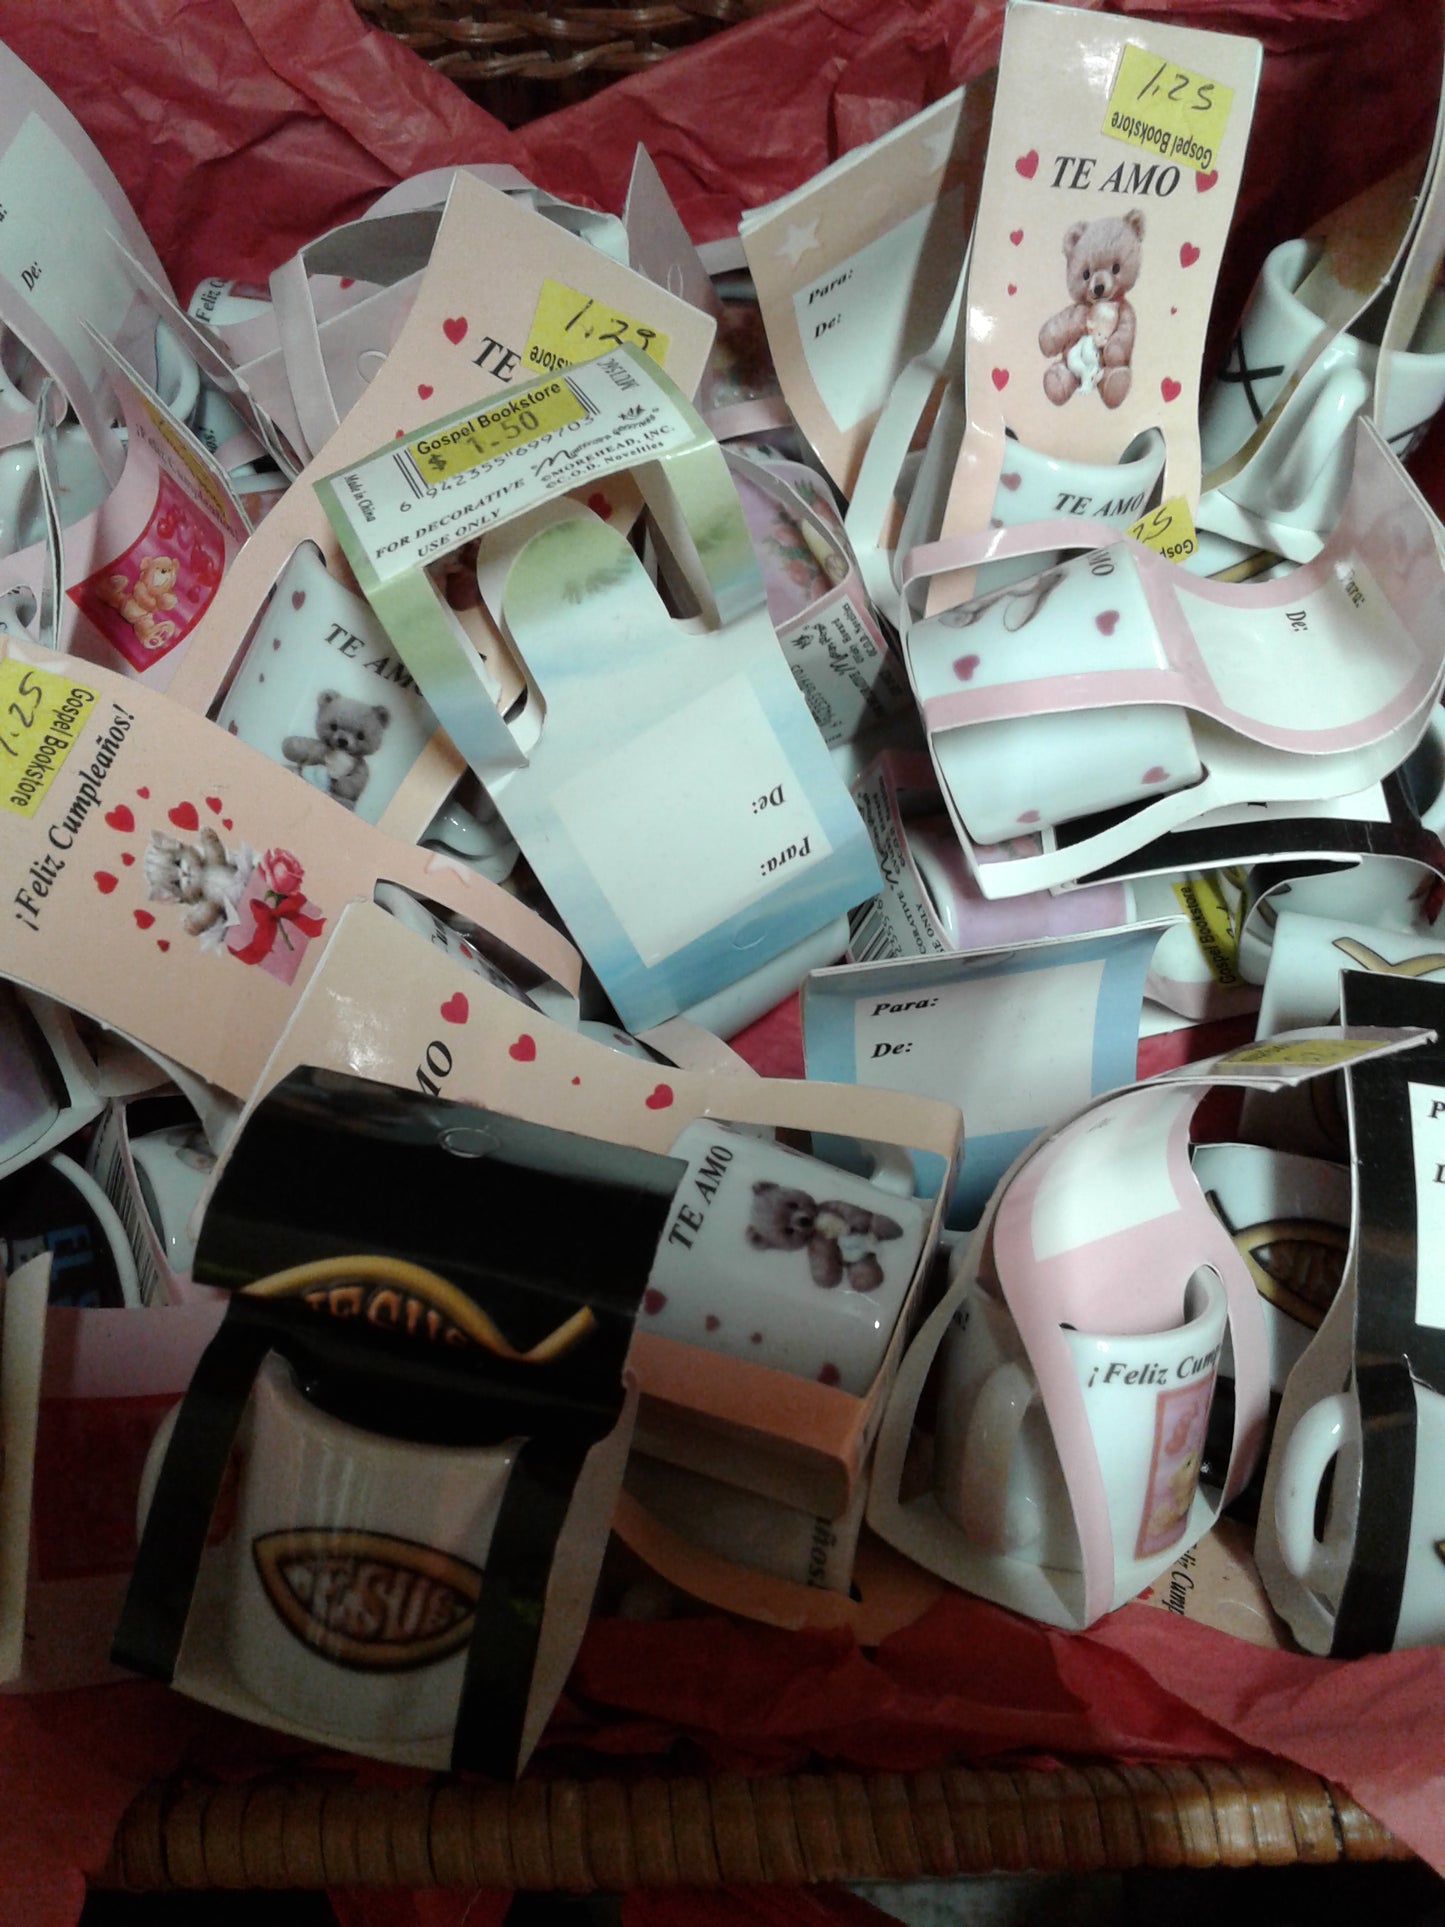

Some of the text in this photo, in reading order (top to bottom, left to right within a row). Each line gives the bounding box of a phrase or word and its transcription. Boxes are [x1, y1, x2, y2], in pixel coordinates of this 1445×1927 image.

[1110, 110, 1214, 170] Gospel Bookstore
[1050, 155, 1181, 198] TE AMO
[21, 261, 42, 292] De:
[807, 269, 855, 307] Para:
[813, 314, 843, 340] De:
[472, 336, 522, 384] TE
[417, 381, 562, 456] Gospel Bookstore
[427, 453, 448, 473] $
[604, 440, 666, 468] Novelties
[358, 498, 376, 522] China
[375, 477, 526, 559] FOR DECORATIVE
[1054, 490, 1145, 517] TE AMO
[417, 508, 502, 558] USE ONLY
[1285, 609, 1309, 634] De:
[324, 623, 366, 658] TE
[10, 688, 95, 807] Gospel Bookstore
[752, 783, 786, 815] De:
[13, 702, 137, 934] ¡Feliz Cumpleaños!
[760, 835, 812, 877] Para:
[871, 994, 939, 1017] Para:
[871, 1039, 913, 1059] De:
[668, 1143, 736, 1253] TE AMO
[1086, 1361, 1169, 1388] ¡Feliz
